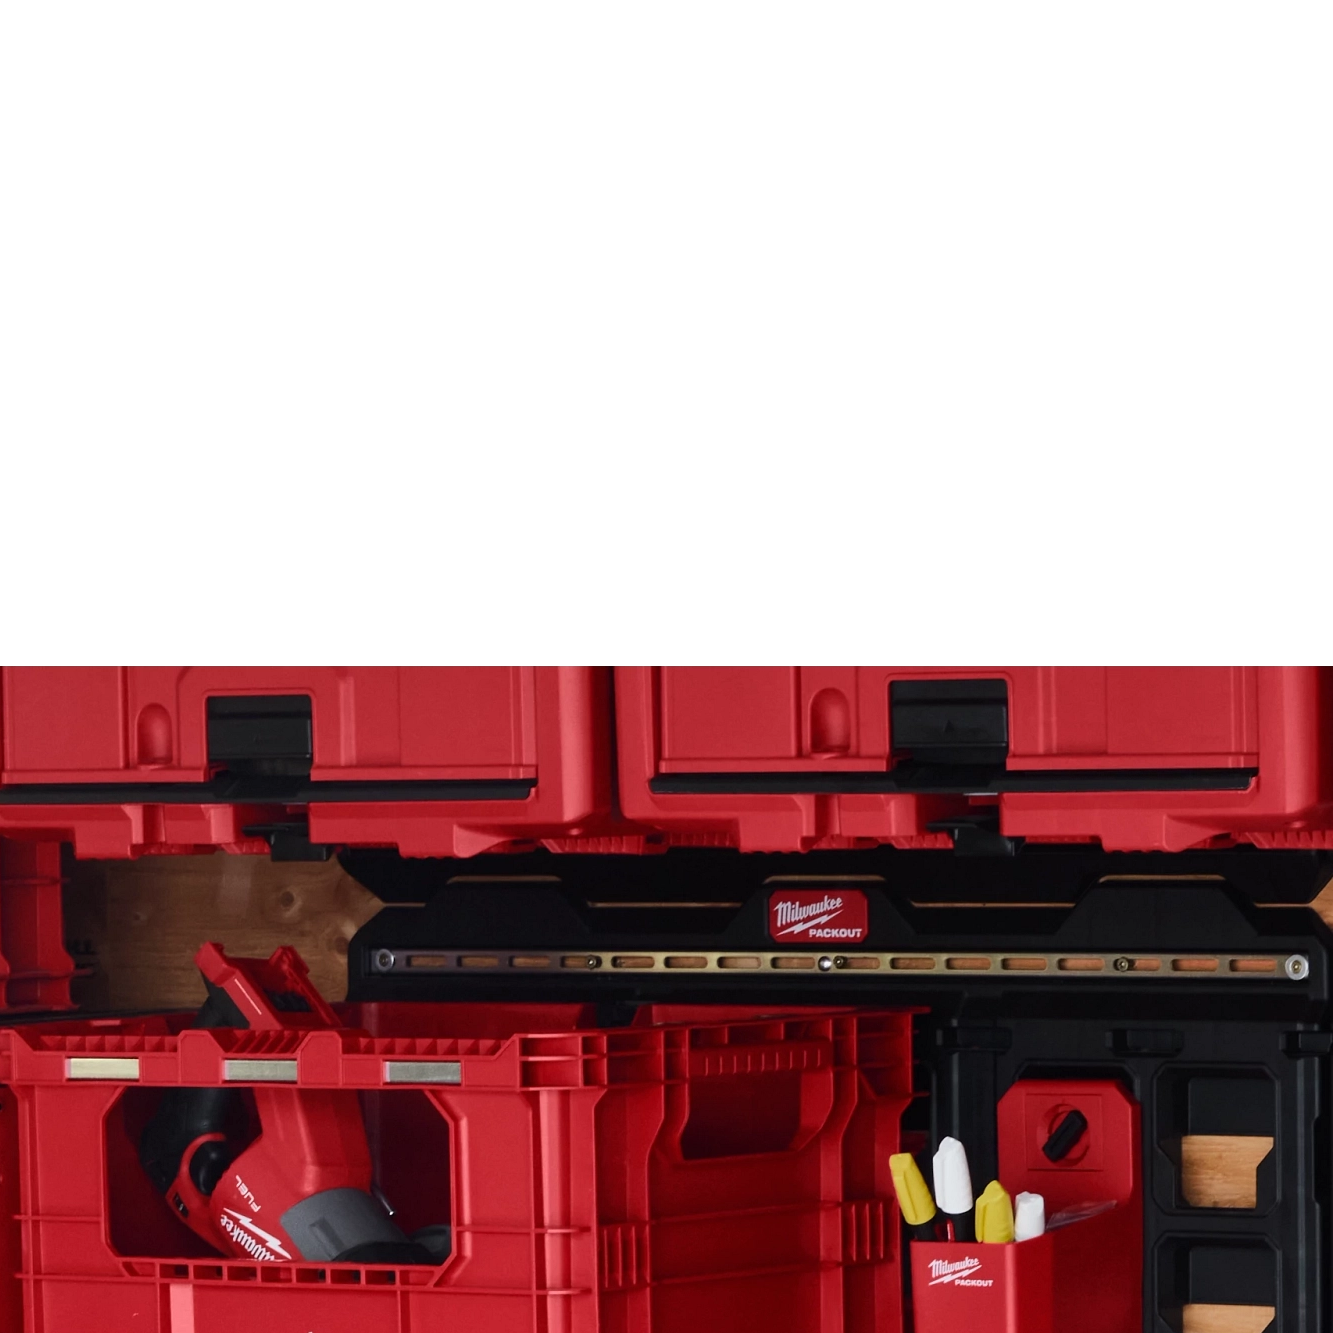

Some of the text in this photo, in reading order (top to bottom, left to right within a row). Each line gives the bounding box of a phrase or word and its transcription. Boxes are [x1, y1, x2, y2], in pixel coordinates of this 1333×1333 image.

[773, 894, 844, 928] Milwaukee
[808, 928, 862, 938] PACKOUT
[235, 1174, 262, 1213] FUEL
[927, 1256, 980, 1279] Milwaukee
[954, 1279, 994, 1287] PACKOUT
